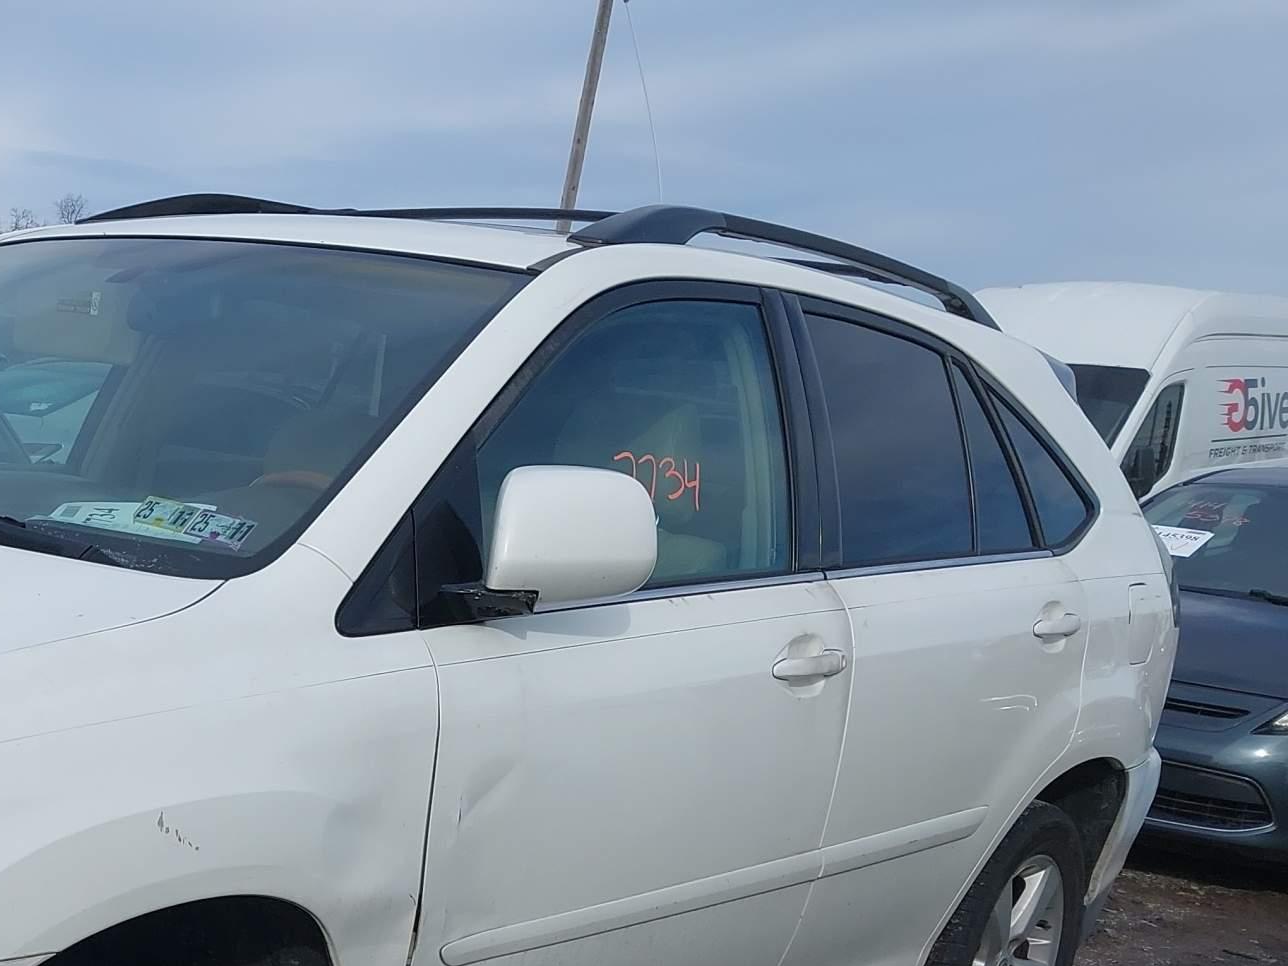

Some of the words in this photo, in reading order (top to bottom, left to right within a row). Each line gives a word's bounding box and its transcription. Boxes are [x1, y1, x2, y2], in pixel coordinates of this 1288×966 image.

[1209, 446, 1241, 458] FREIGHT
[613, 451, 700, 511] 7734
[136, 500, 160, 519] 25
[191, 513, 216, 532] 25
